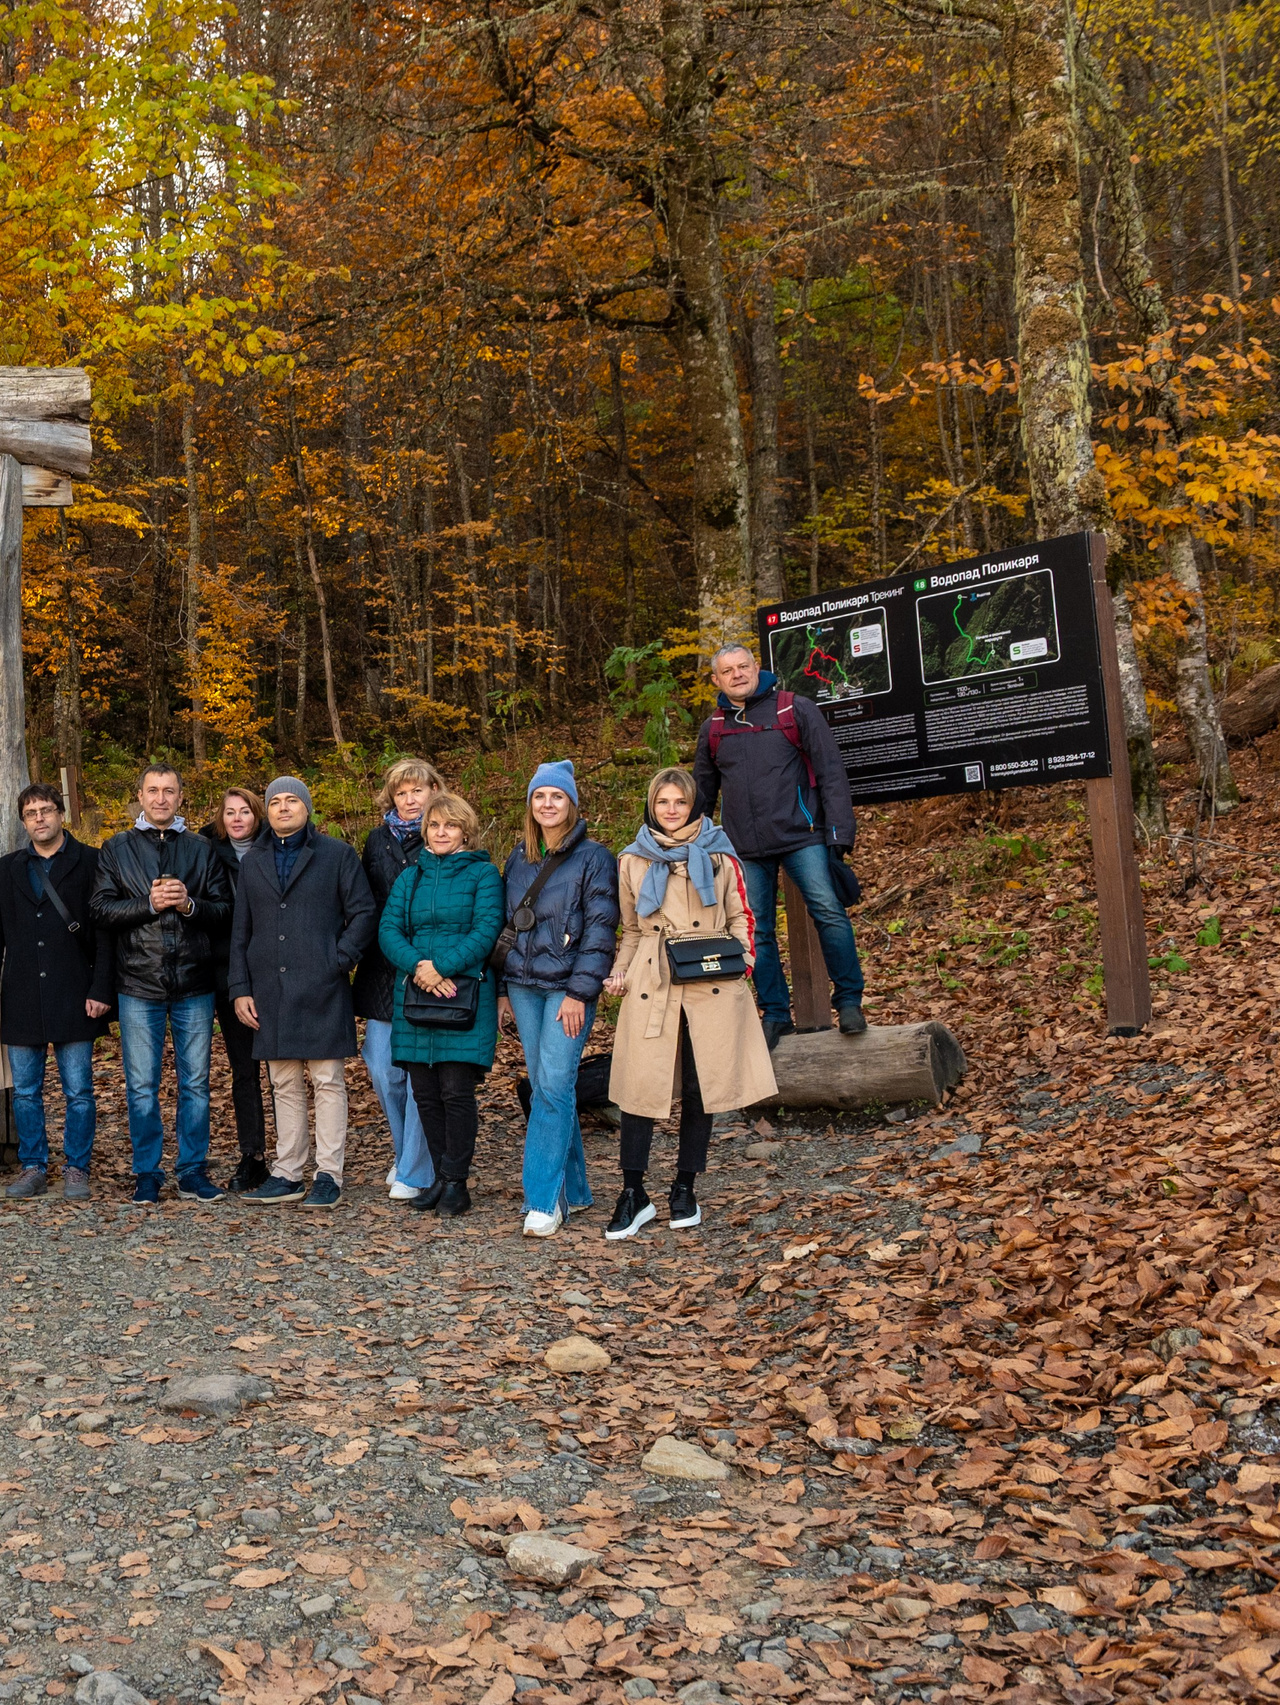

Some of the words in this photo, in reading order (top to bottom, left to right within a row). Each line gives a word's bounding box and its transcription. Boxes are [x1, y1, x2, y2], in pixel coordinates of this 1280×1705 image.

[930, 568, 980, 588] Водопад
[982, 554, 1040, 577] Поликаря
[780, 605, 822, 622] Водопад
[822, 594, 869, 611] Поликаря
[869, 587, 905, 604] Трекинг
[995, 763, 1007, 771] 800
[1007, 759, 1039, 769] 550-20-20
[1053, 755, 1065, 763] 928
[1065, 751, 1096, 762] 294-17-12
